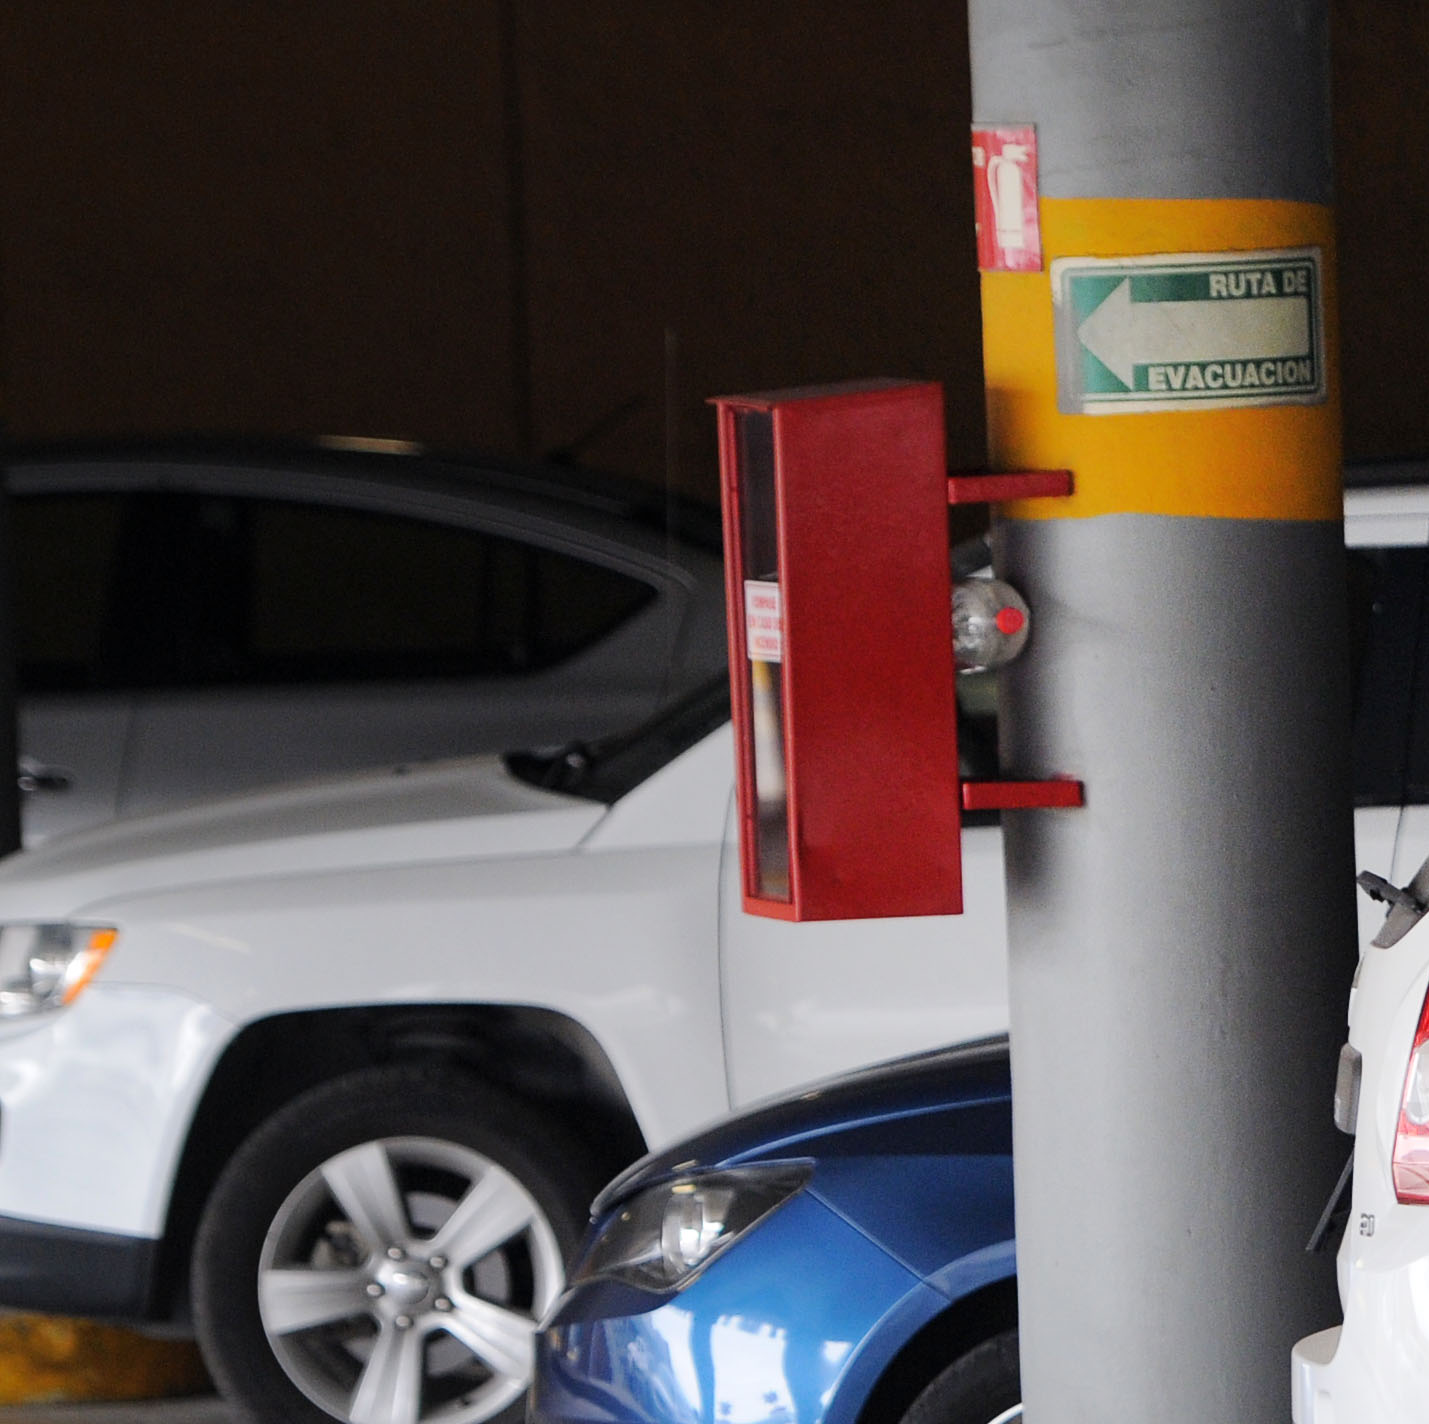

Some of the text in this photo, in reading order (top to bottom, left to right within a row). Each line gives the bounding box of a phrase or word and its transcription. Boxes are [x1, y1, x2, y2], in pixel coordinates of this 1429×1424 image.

[1210, 270, 1308, 297] RUTA DE
[1148, 359, 1310, 391] EVACUACION
